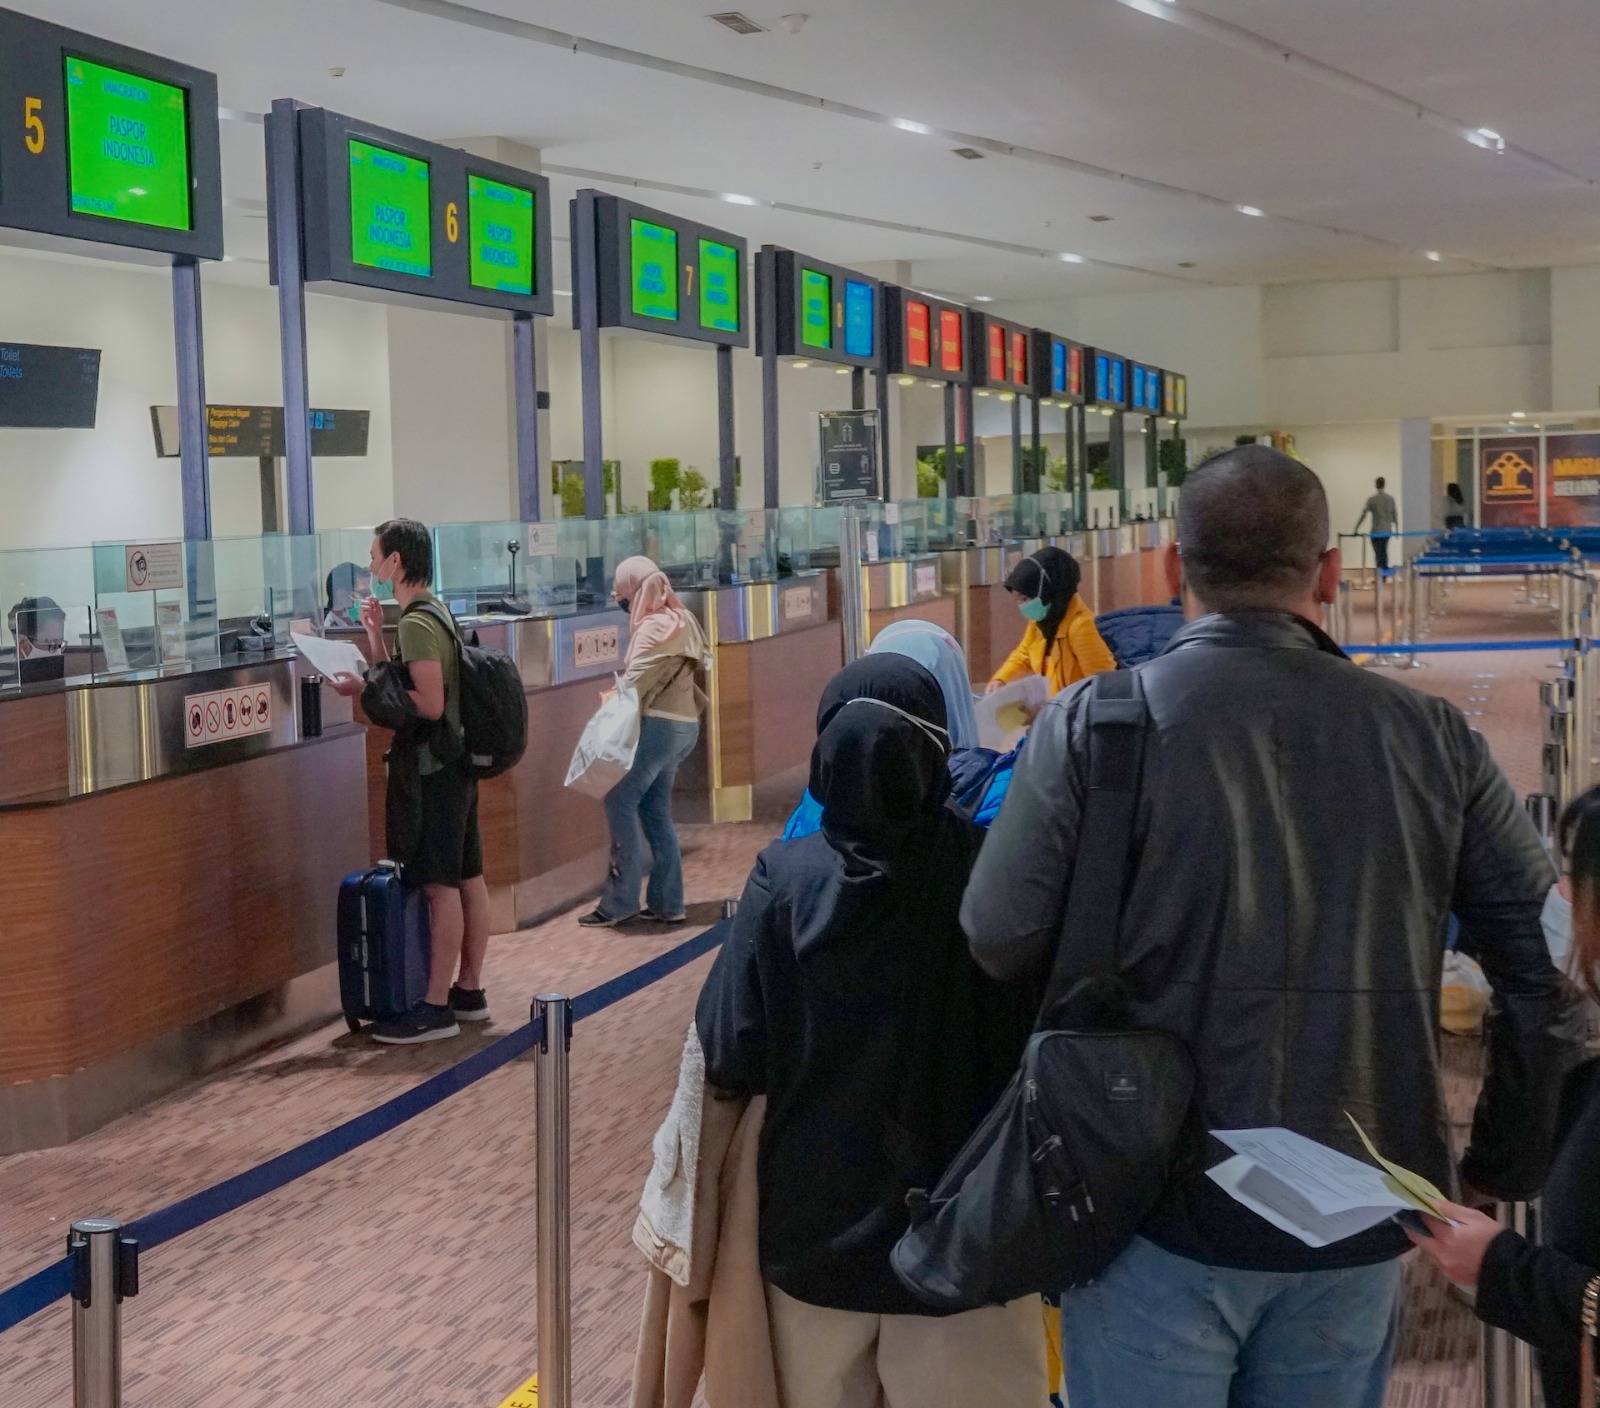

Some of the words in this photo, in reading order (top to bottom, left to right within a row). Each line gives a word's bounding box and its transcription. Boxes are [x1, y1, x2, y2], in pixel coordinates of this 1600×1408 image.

[24, 96, 46, 154] 5
[109, 115, 147, 142] PASPOR
[103, 138, 155, 168] INDONESIA
[375, 204, 406, 226] PASPOR
[446, 202, 459, 243] 6
[369, 226, 412, 248] INDONESIA
[487, 223, 513, 242] PASPOR
[685, 265, 694, 297] 7
[1, 347, 20, 361] Toilet
[0, 364, 23, 379] Toilets
